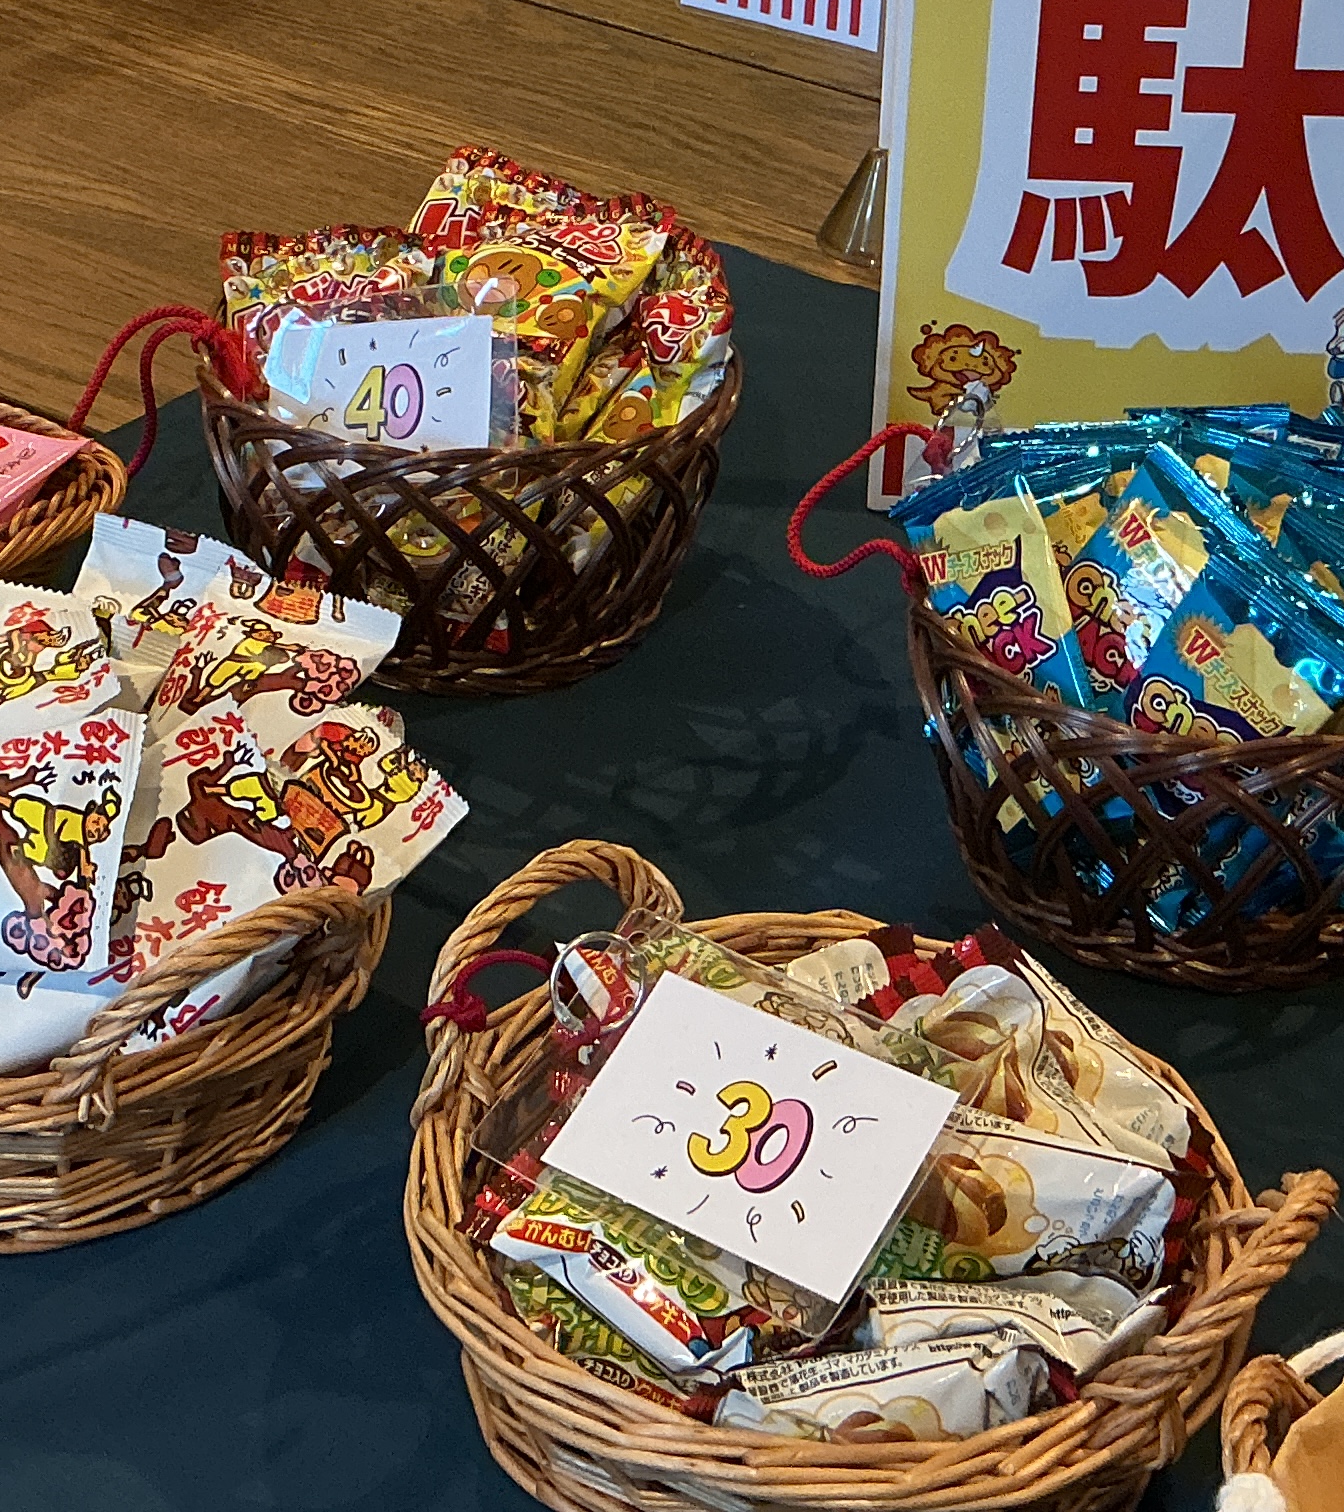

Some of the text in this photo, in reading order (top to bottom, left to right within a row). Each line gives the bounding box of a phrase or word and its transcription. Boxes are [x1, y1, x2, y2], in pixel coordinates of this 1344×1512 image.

[343, 363, 424, 441] 40
[161, 710, 246, 768] 太郎
[87, 879, 232, 986] 餅太郎
[686, 1080, 814, 1194] 30
